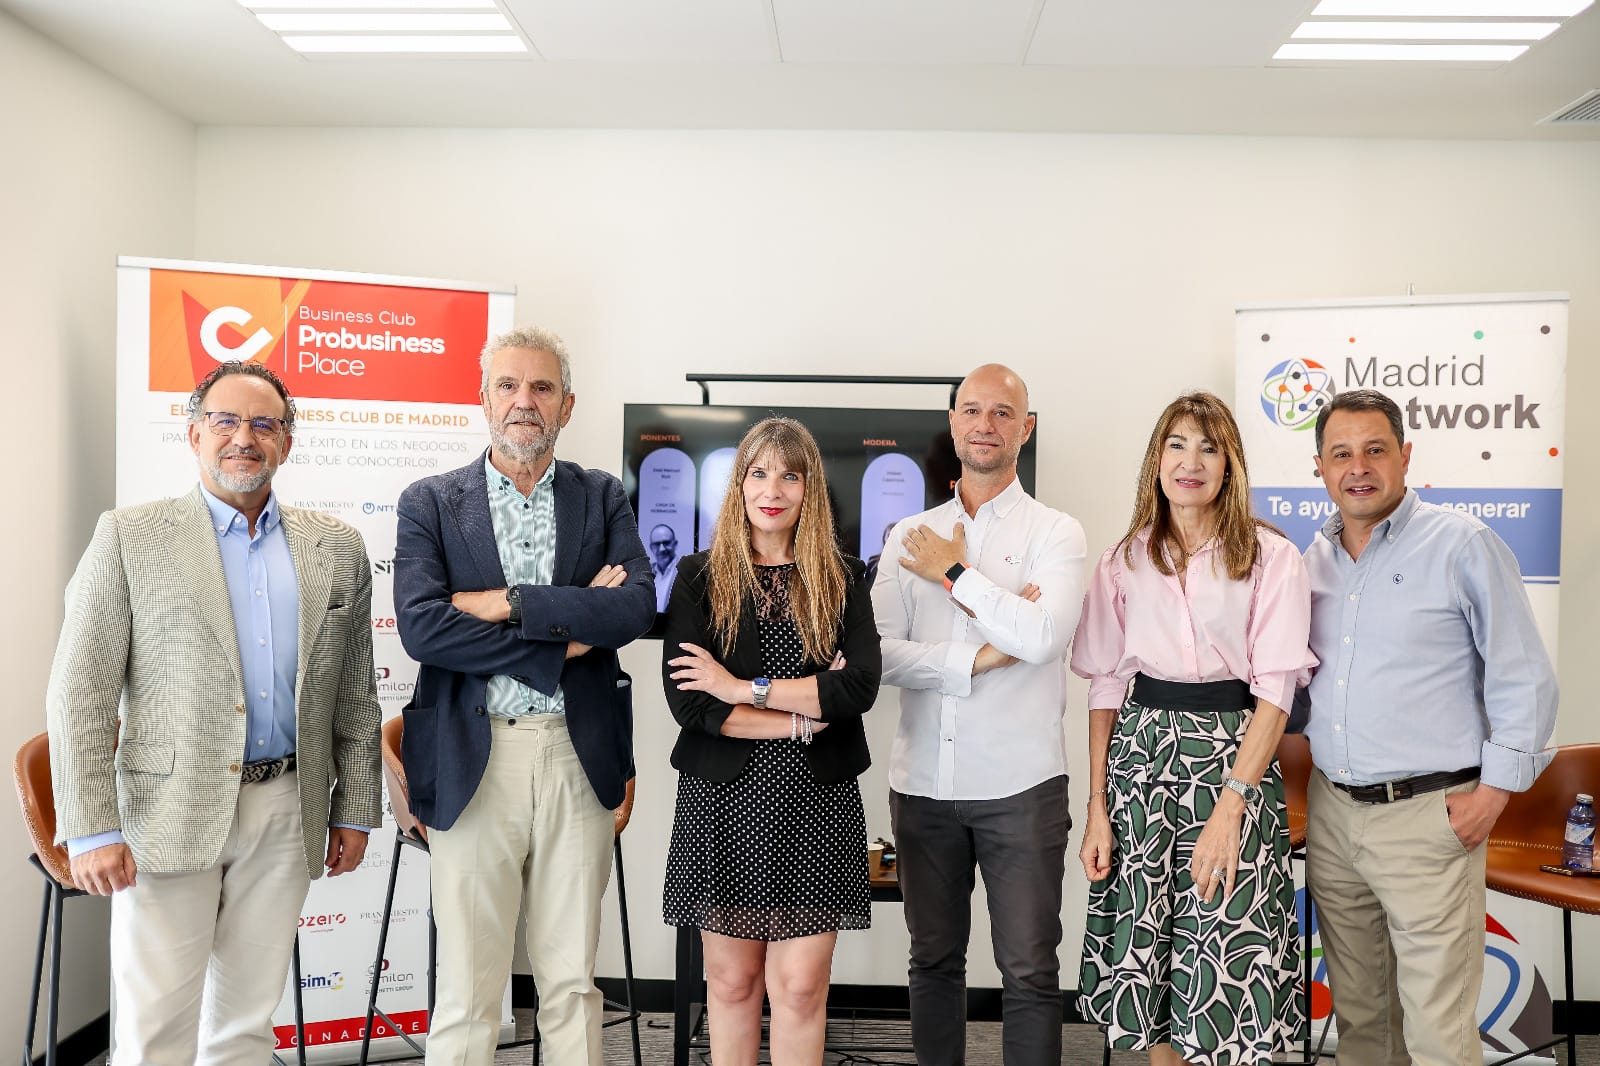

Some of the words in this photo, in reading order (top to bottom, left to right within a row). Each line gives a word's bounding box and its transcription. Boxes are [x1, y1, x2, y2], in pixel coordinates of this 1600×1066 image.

[299, 305, 374, 324] Business
[378, 310, 416, 326] Club
[299, 324, 445, 354] Probusiness
[299, 351, 365, 376] Place
[1345, 354, 1484, 387] Madrid
[295, 409, 335, 422] NESS
[339, 411, 380, 424] CLUB
[384, 413, 406, 425] DE
[408, 413, 469, 427] MADRID
[1405, 394, 1540, 430] twork
[310, 436, 346, 449] ÉXITO
[351, 439, 368, 449] EN
[374, 439, 398, 450] LOS
[640, 434, 681, 442] PONENTES
[863, 439, 897, 447] MODERA
[314, 454, 344, 466] QUE
[1268, 496, 1292, 516] Te
[1298, 501, 1339, 520] ayu
[378, 681, 415, 692] milon
